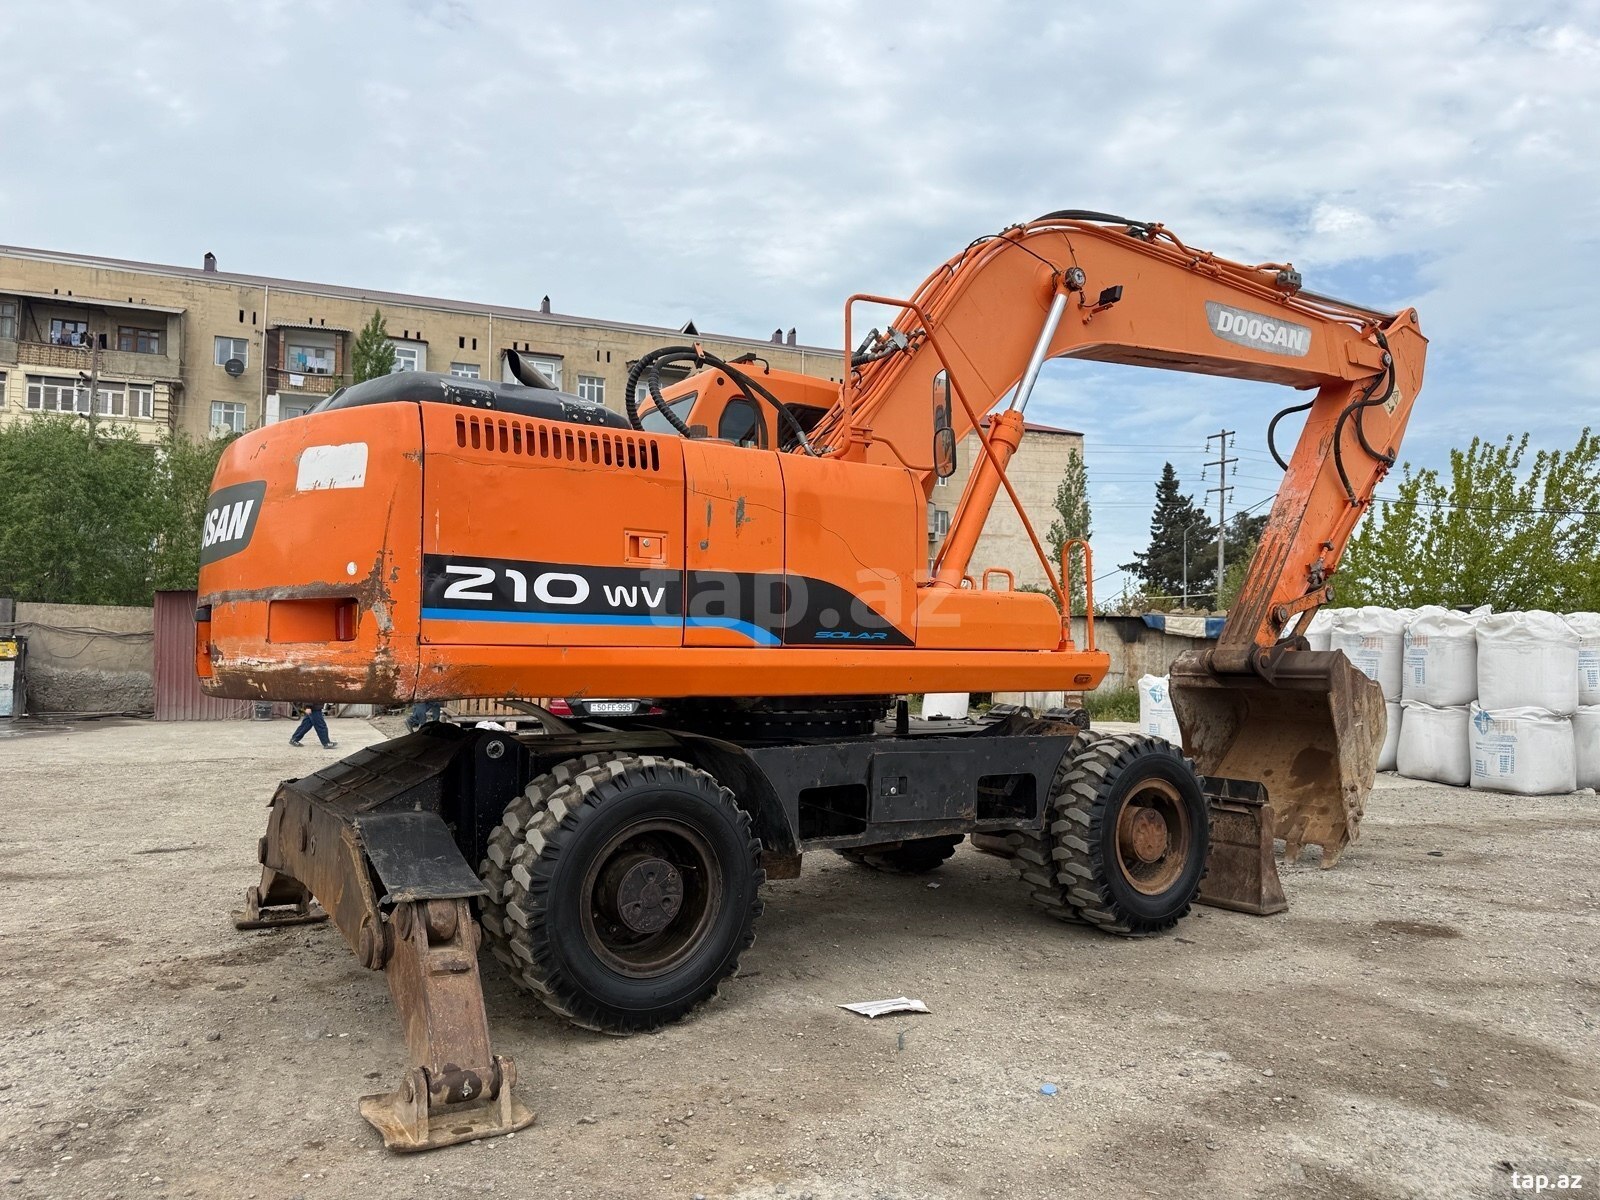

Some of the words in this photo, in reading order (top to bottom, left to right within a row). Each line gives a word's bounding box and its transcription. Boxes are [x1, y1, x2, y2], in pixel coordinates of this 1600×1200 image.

[1216, 310, 1304, 350] DOOSAN
[201, 499, 255, 551] OSAN
[443, 564, 590, 605] 210
[603, 585, 665, 608] WV
[814, 631, 888, 640] SOLAR
